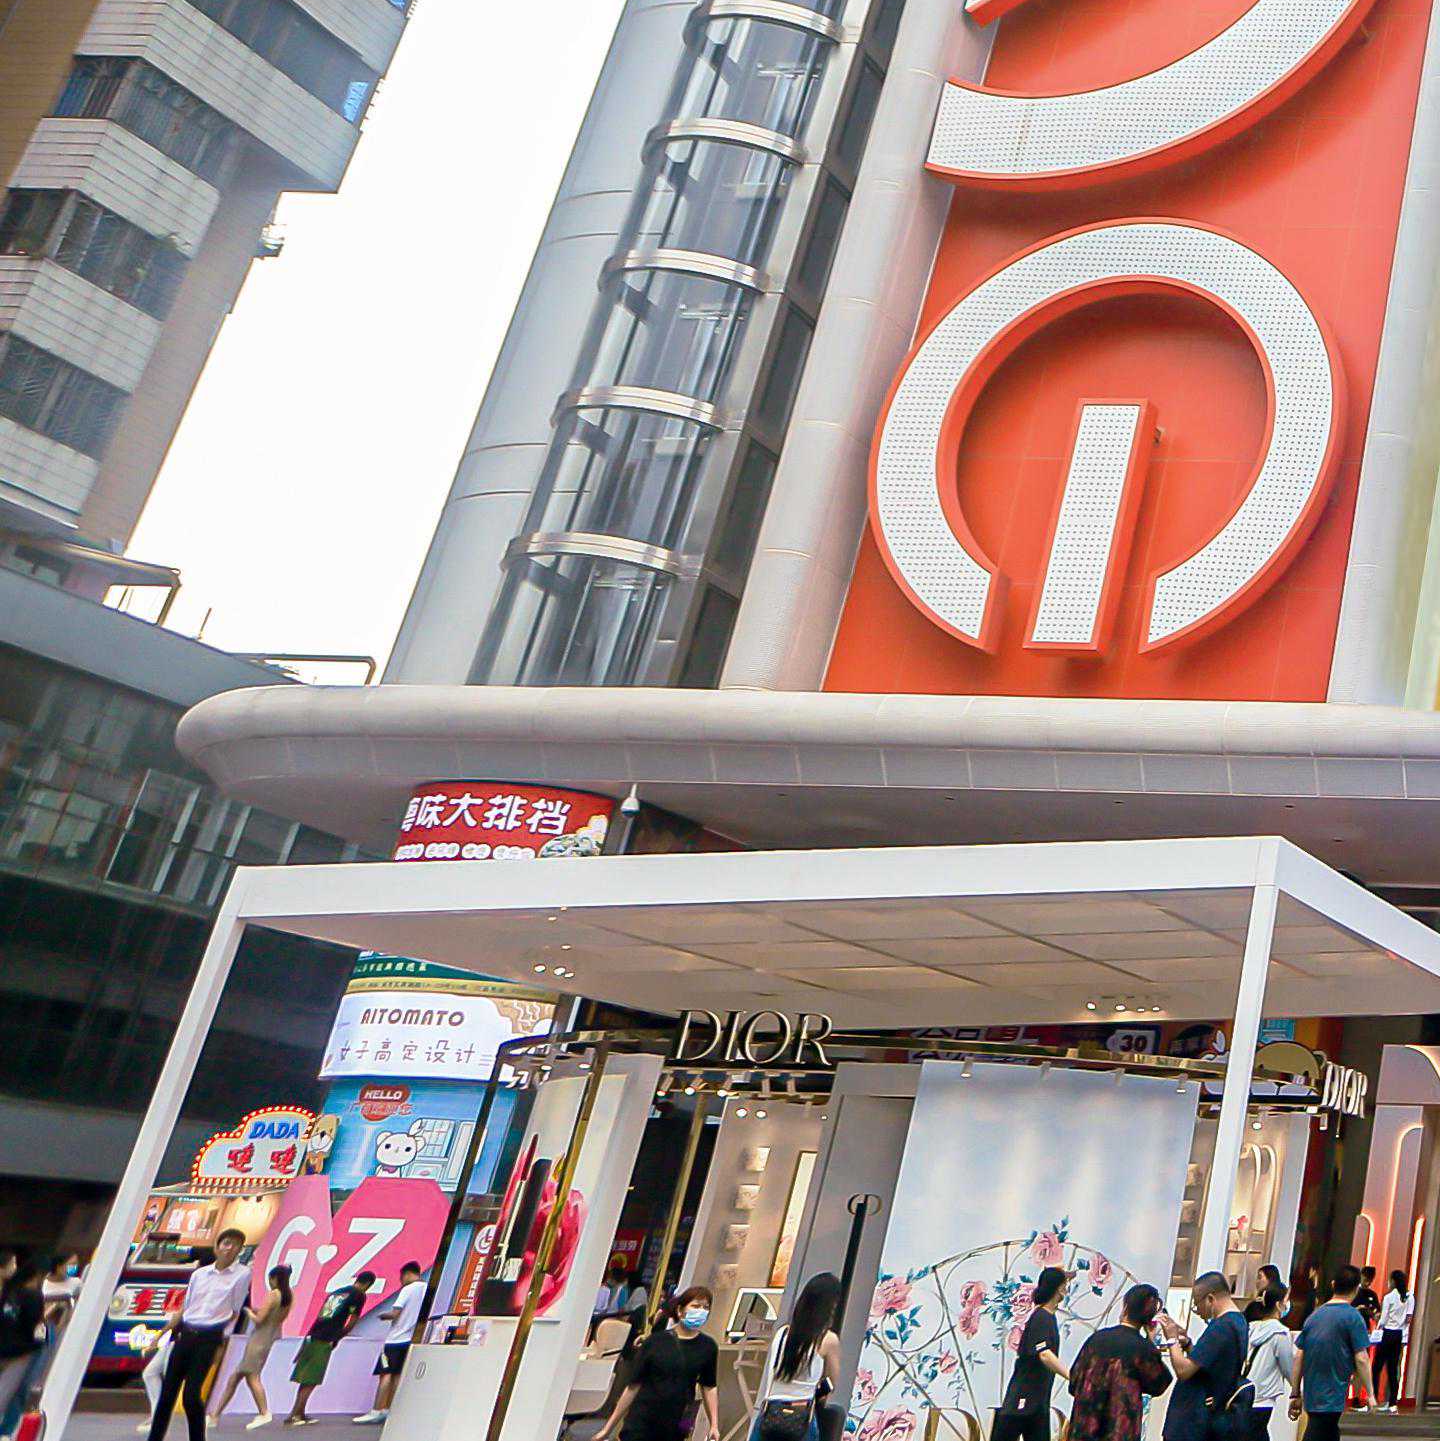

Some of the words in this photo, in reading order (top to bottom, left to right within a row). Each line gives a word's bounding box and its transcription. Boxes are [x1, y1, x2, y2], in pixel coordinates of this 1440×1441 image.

[672, 1010, 832, 1065] DIOR
[1118, 1034, 1147, 1053] 30
[1320, 1061, 1368, 1119] DIOR
[249, 1121, 300, 1140] DADA
